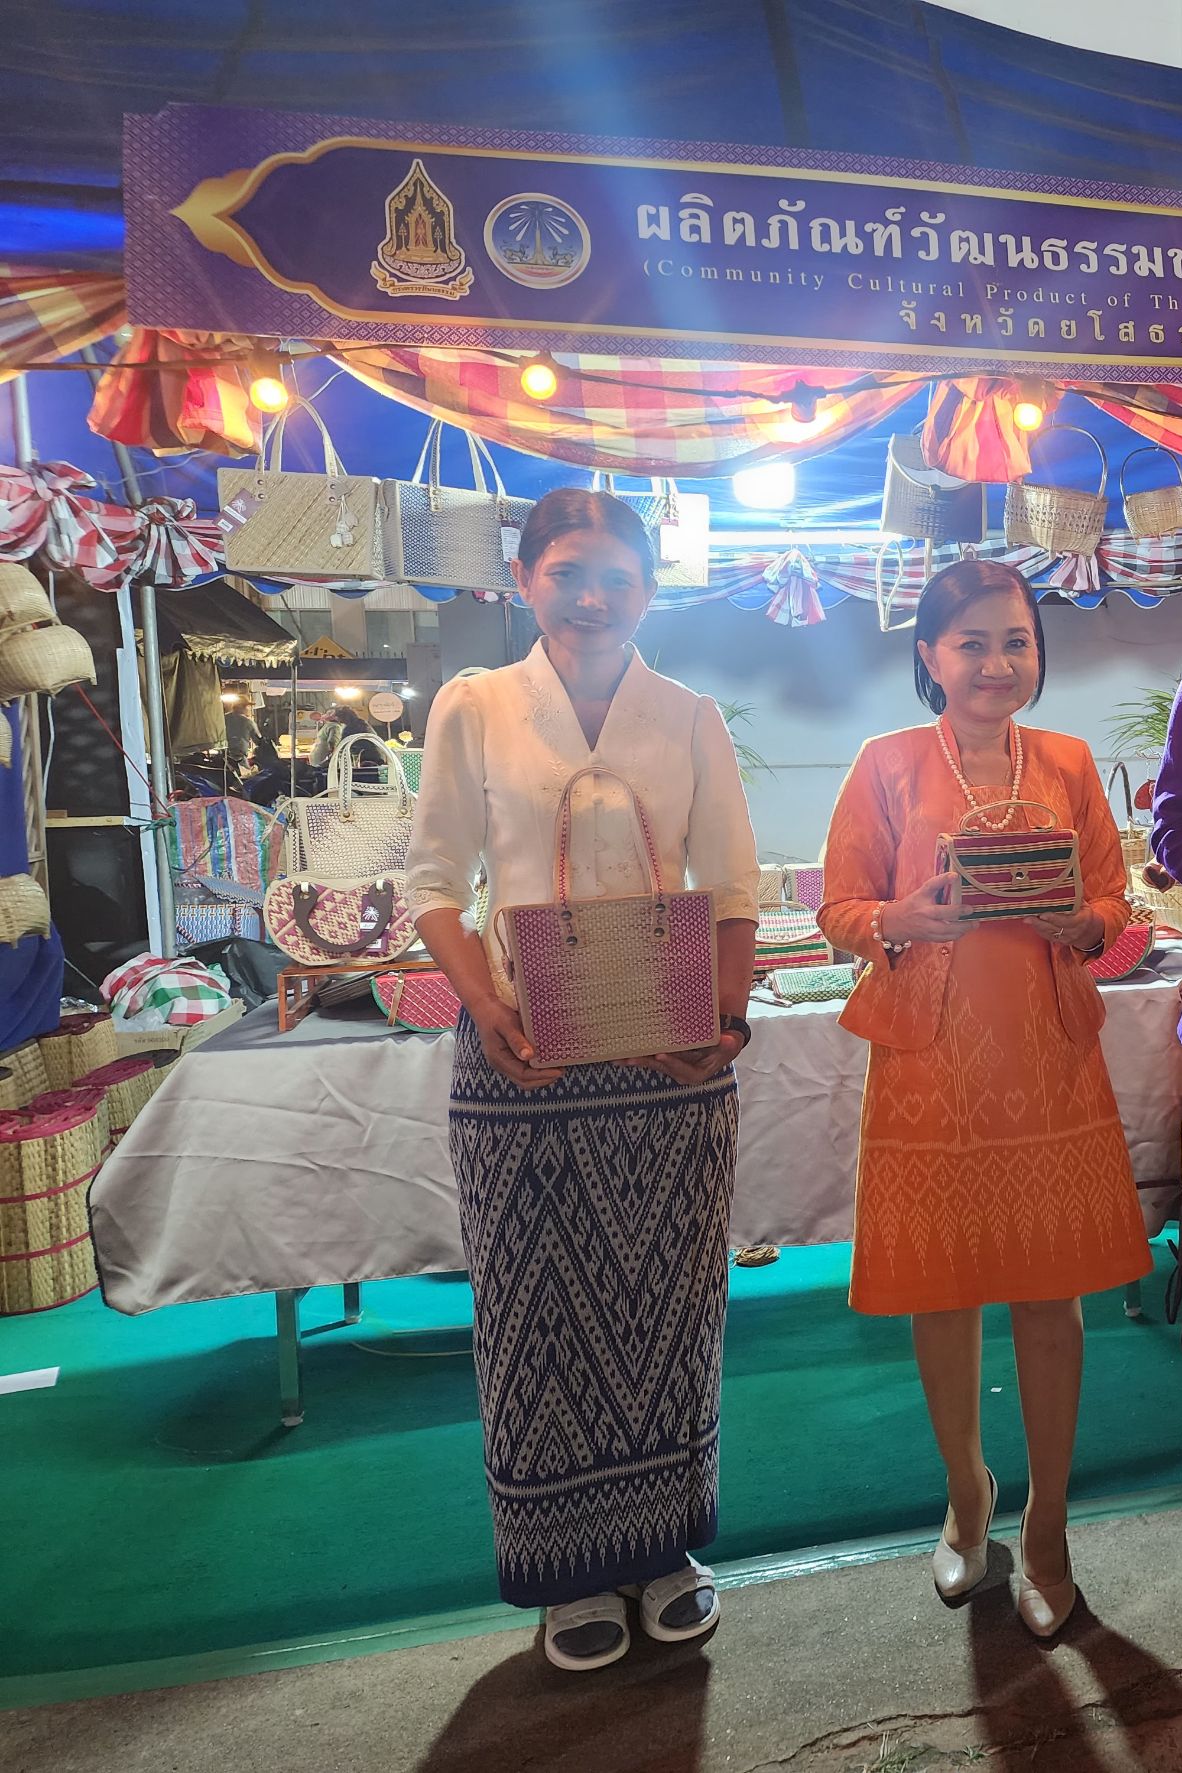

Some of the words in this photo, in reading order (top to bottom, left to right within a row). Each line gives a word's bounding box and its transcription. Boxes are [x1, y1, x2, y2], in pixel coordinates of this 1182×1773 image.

[643, 259, 825, 290] (Community
[848, 273, 964, 297] Cultural
[985, 284, 1088, 306] Product
[1108, 293, 1131, 308] of
